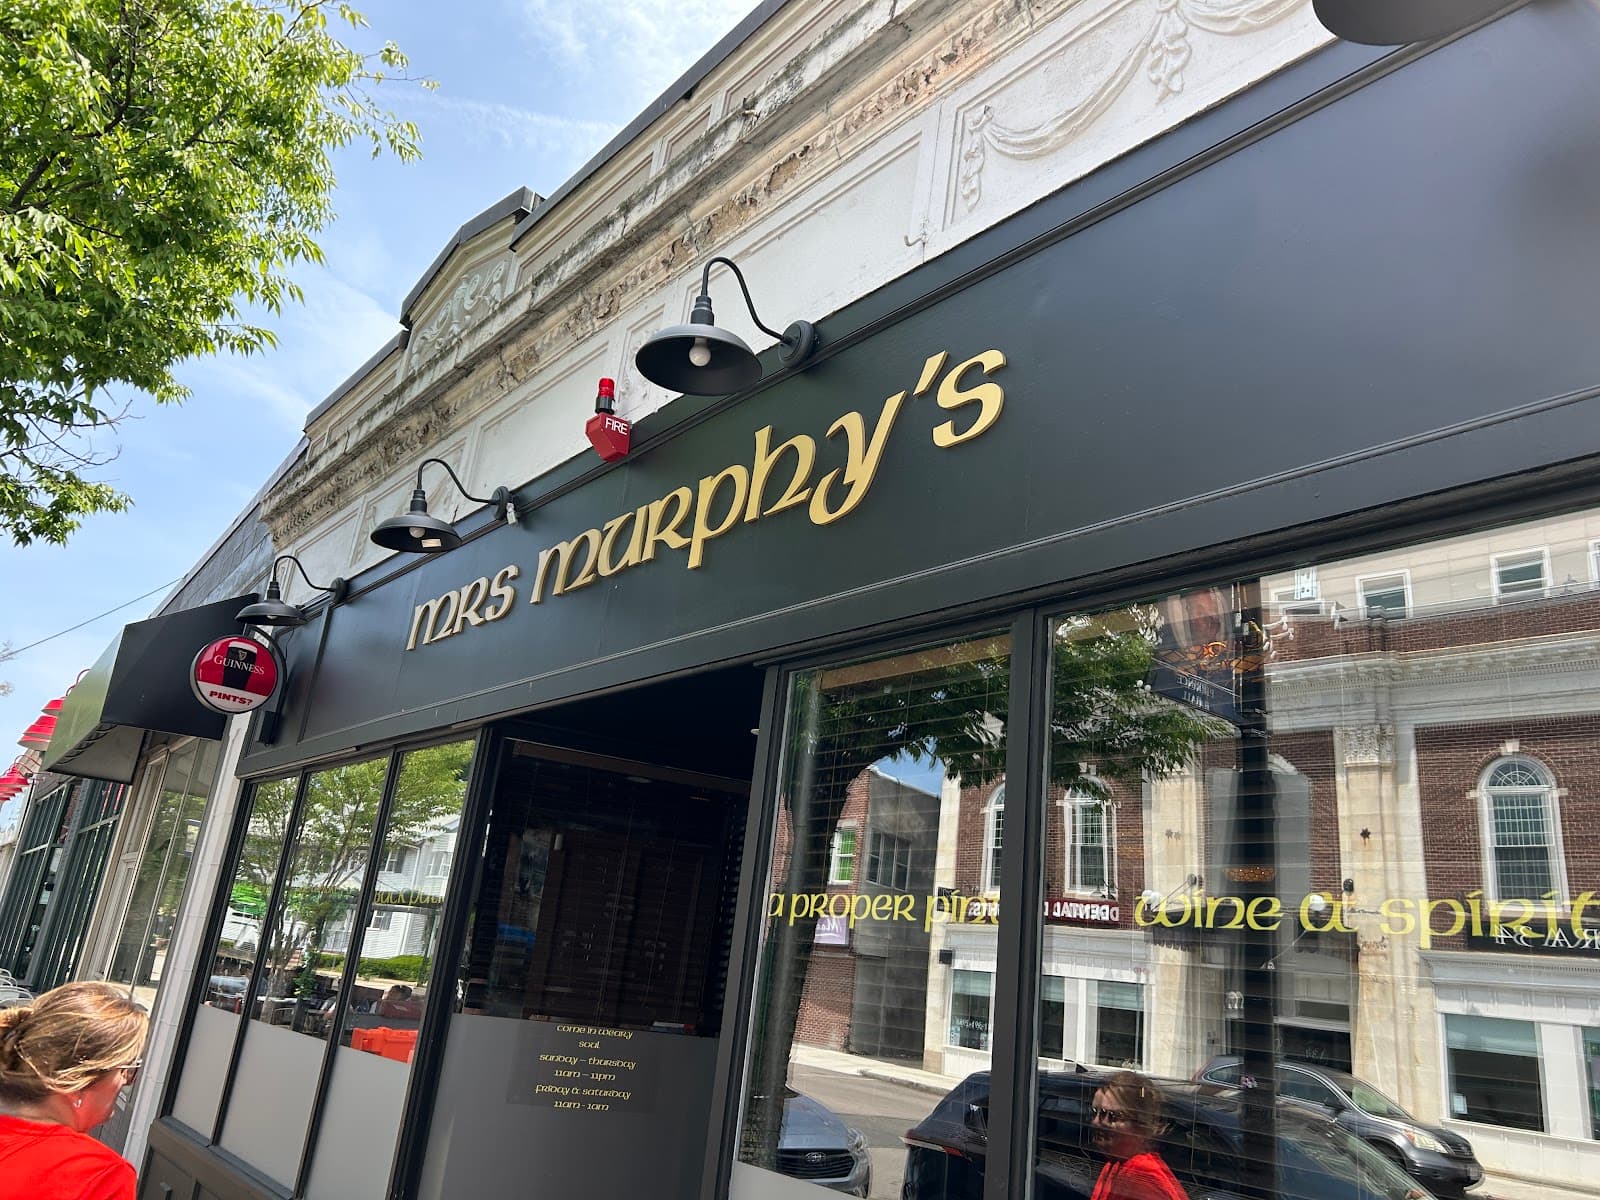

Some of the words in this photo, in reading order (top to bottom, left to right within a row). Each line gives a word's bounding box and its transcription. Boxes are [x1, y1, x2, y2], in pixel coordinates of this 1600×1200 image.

[605, 417, 628, 436] FIRE
[214, 655, 265, 675] GUINNESS
[209, 690, 254, 705] PINTS?
